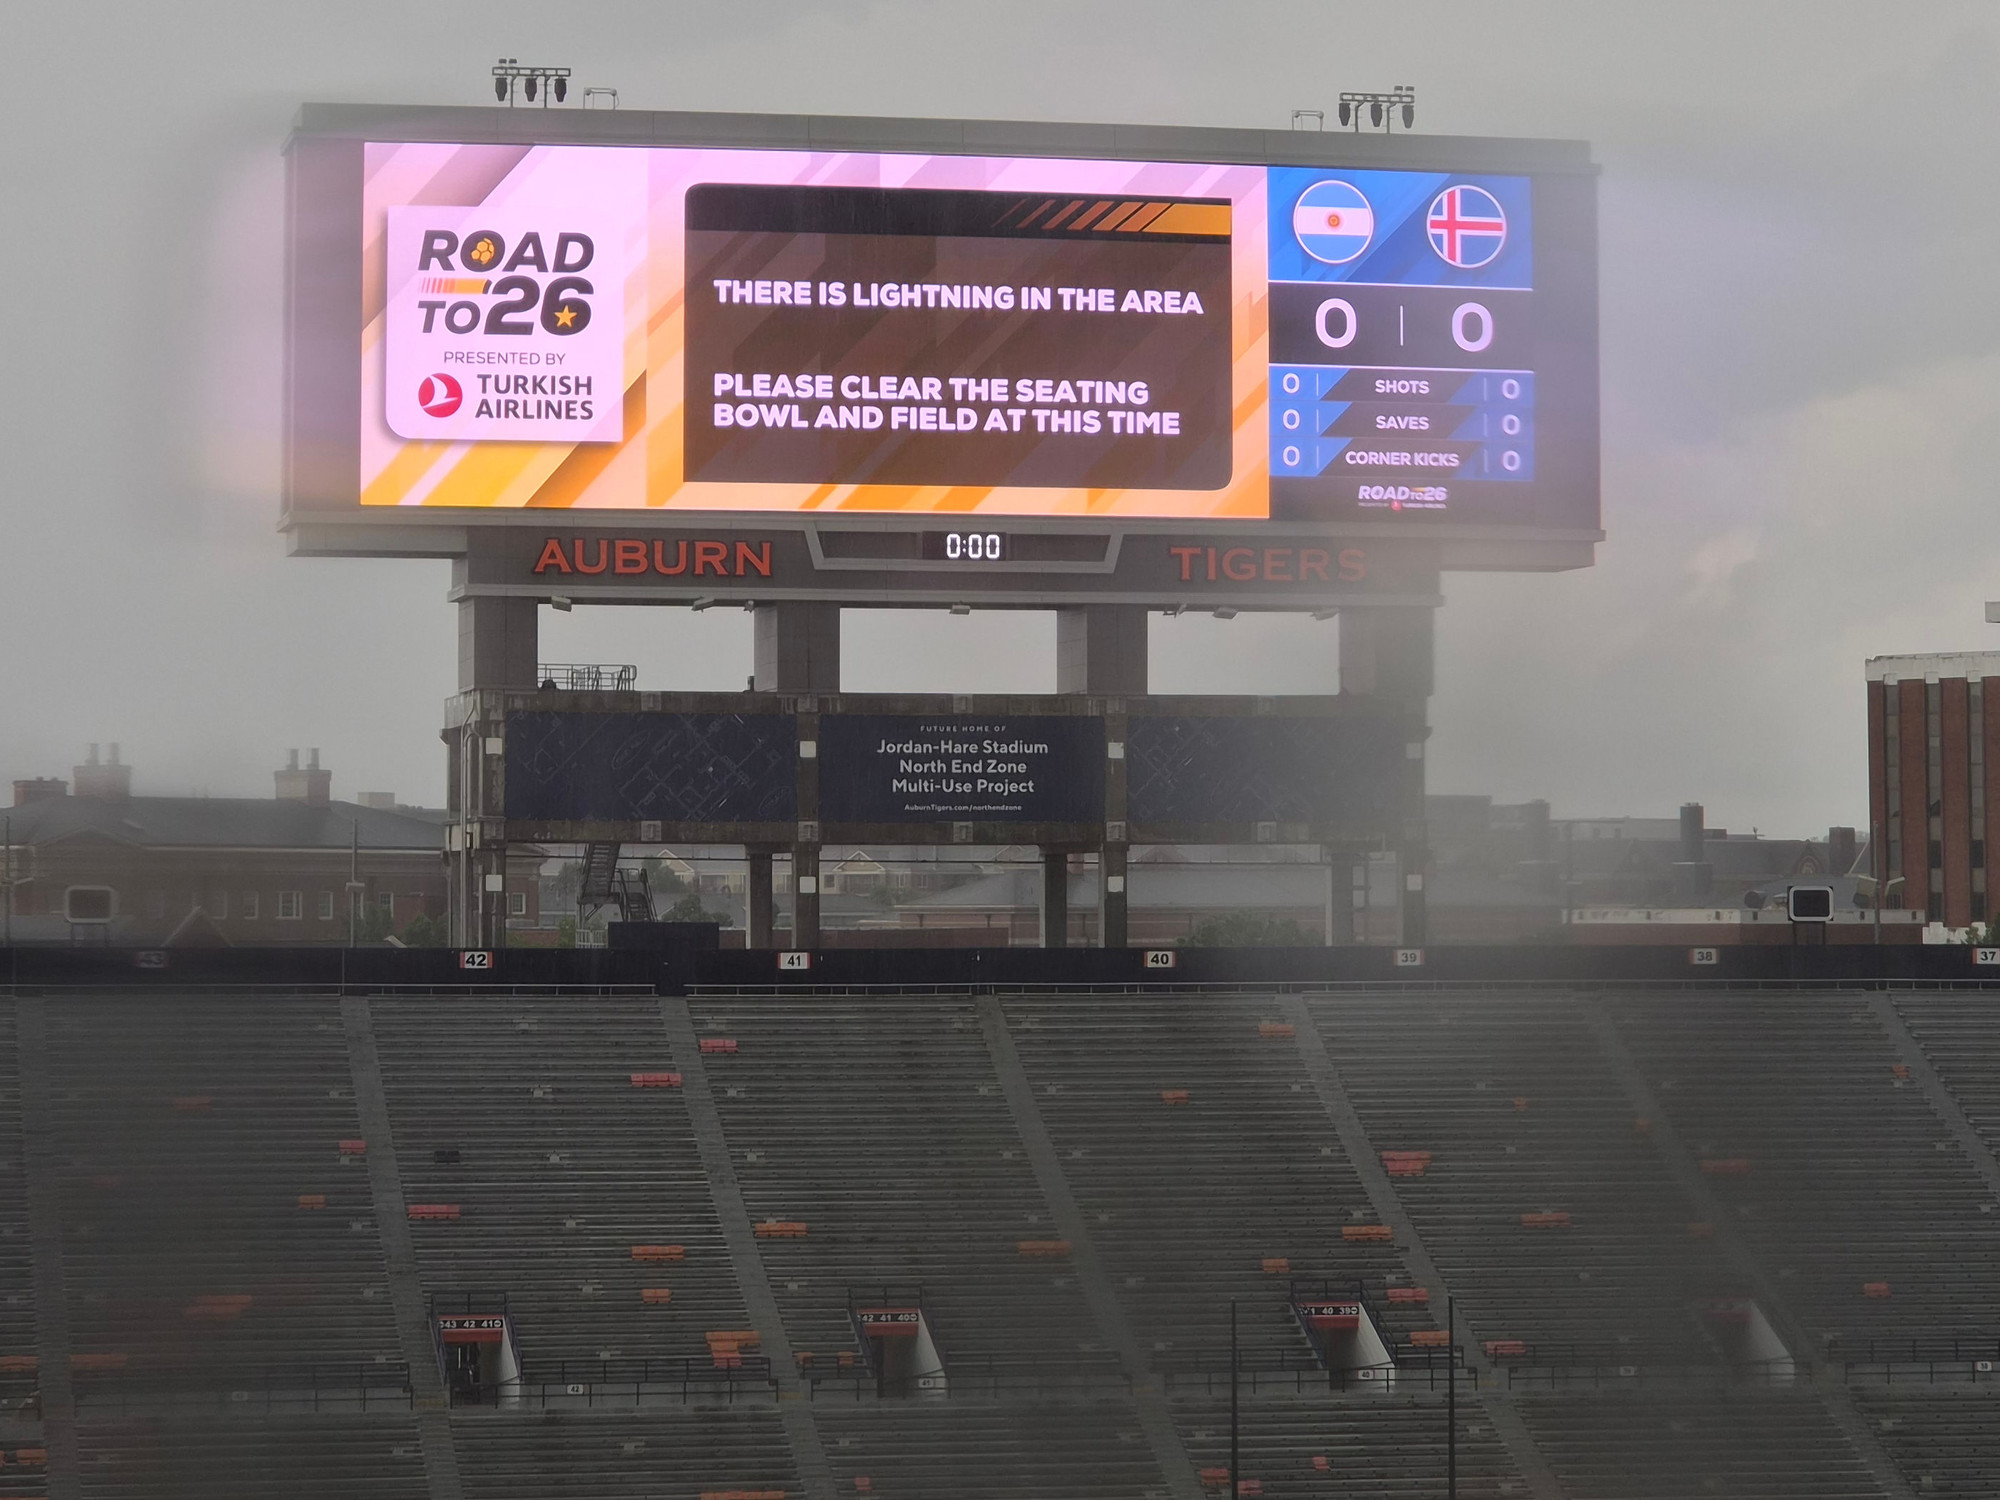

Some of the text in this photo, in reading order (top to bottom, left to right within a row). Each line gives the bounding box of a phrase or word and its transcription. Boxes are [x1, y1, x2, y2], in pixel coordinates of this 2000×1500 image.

[418, 229, 594, 273] ROAD
[713, 279, 1204, 315] THERE IS LIGHTNING IN THE AREA
[418, 300, 481, 334] TO
[1315, 298, 1357, 348] 0
[1451, 302, 1493, 352] 0
[444, 351, 566, 366] PRESENTED BY
[476, 373, 592, 396] TURKISH
[713, 372, 1149, 405] PLEASE CLEAR THE SEATING
[1282, 372, 1520, 400] 0 SHOTS 0
[475, 398, 593, 420] AIRLINES
[713, 403, 1181, 435] BOWL AND FIELD AT THIS TIME
[1282, 408, 1521, 436] 0 SAVES 0
[1282, 445, 1521, 472] 0 CORNER KICKS 0
[1358, 485, 1410, 500] ROAD
[946, 533, 1000, 559] 0:00
[533, 538, 772, 576] AUBURN
[1170, 546, 1367, 582] TIGERS
[877, 739, 1048, 754] Jordan-Hare Stadium
[900, 759, 1027, 774] North End Zone
[892, 778, 1035, 796] Multi-Use Project
[904, 803, 1022, 812] AuburnTigers.com/northendzone
[465, 953, 487, 967] 42
[787, 954, 802, 967] 41
[1150, 953, 1169, 965] 40
[1401, 952, 1417, 963] 39
[1697, 951, 1713, 962] 38
[1980, 951, 1996, 962] 37
[861, 1314, 874, 1322] 42
[880, 1314, 892, 1322] 41
[1322, 1307, 1334, 1315] 40
[444, 1320, 493, 1329] 43 42 41
